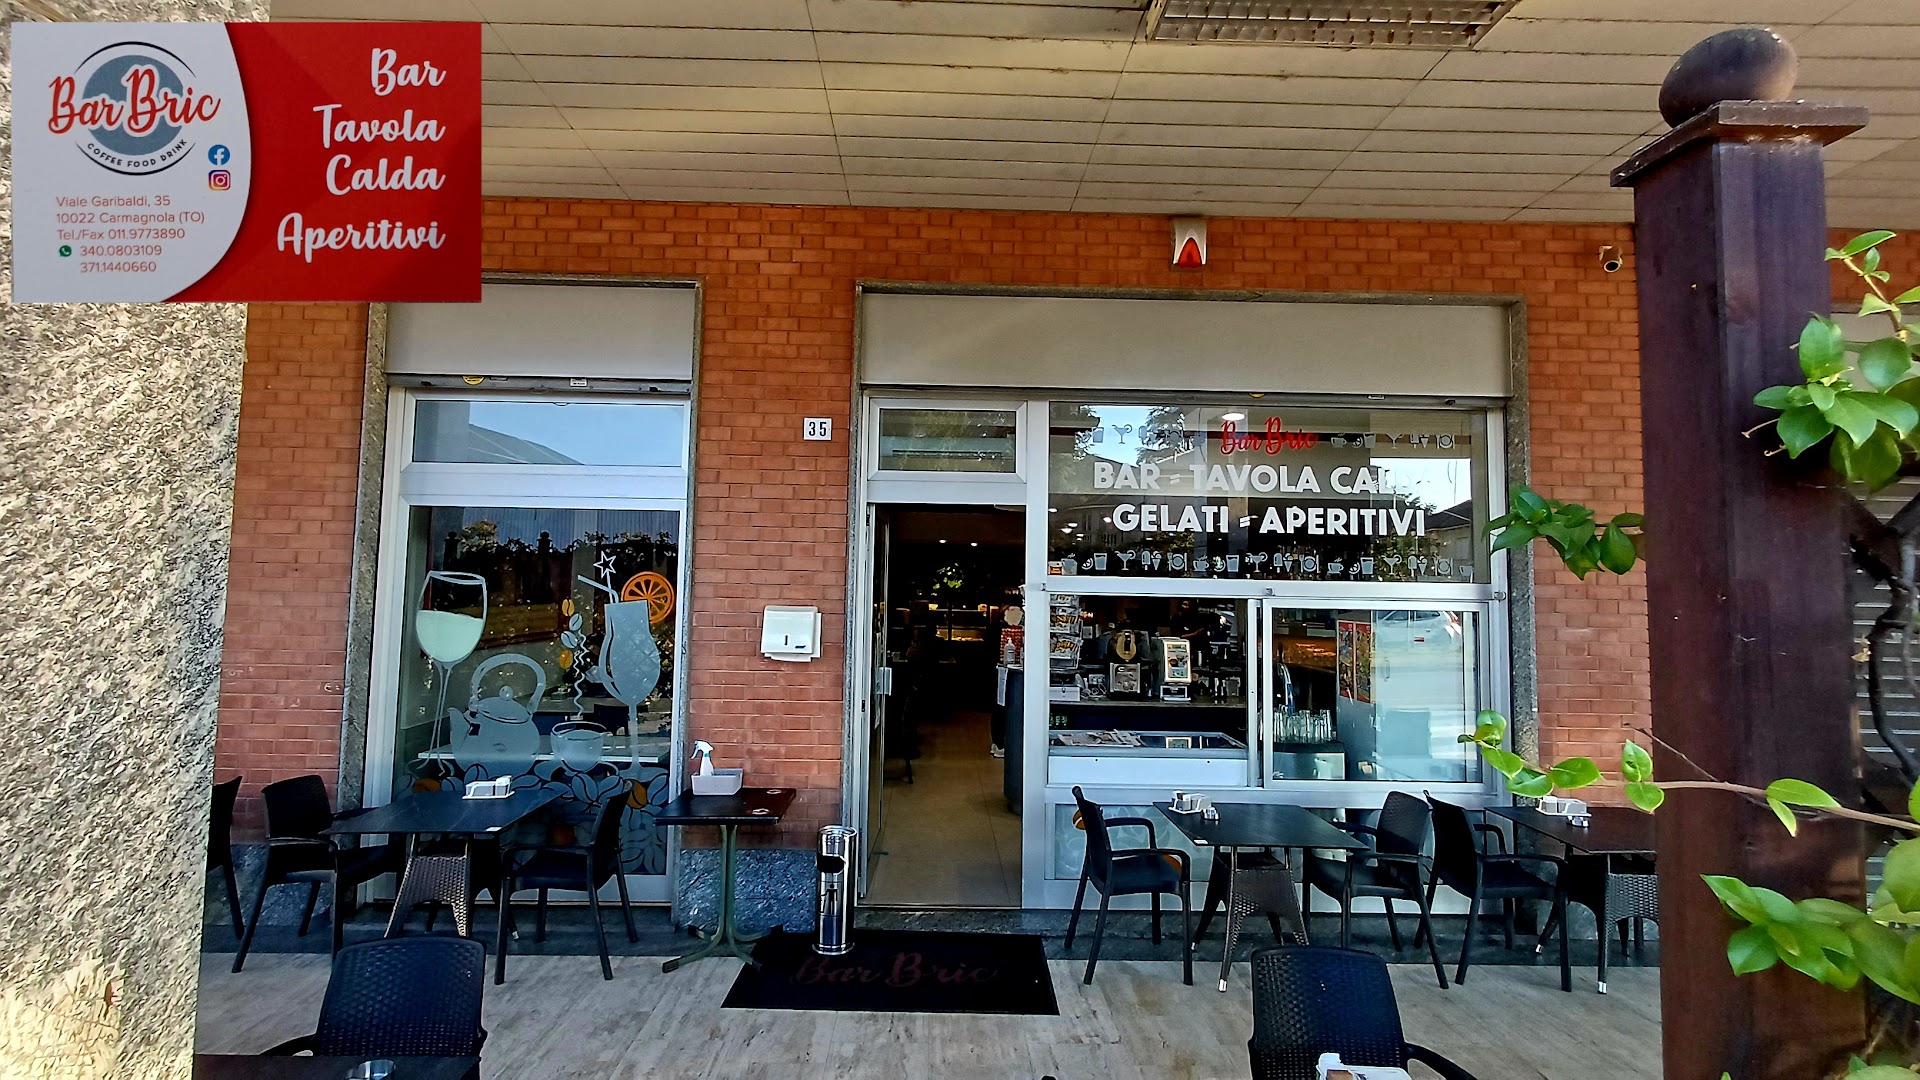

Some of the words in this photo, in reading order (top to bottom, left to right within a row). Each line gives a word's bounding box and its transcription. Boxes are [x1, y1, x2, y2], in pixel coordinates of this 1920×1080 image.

[808, 421, 828, 437] 35
[1220, 420, 1263, 455] Bar
[1264, 416, 1319, 455] Bric
[1094, 461, 1160, 490] BAR
[1189, 464, 1321, 494] TAVOLA
[1330, 466, 1425, 494] CAL
[1112, 503, 1229, 533] GELATI
[1259, 505, 1426, 537] APERITIVI
[788, 954, 882, 985] Bar
[884, 952, 999, 987] Bric
